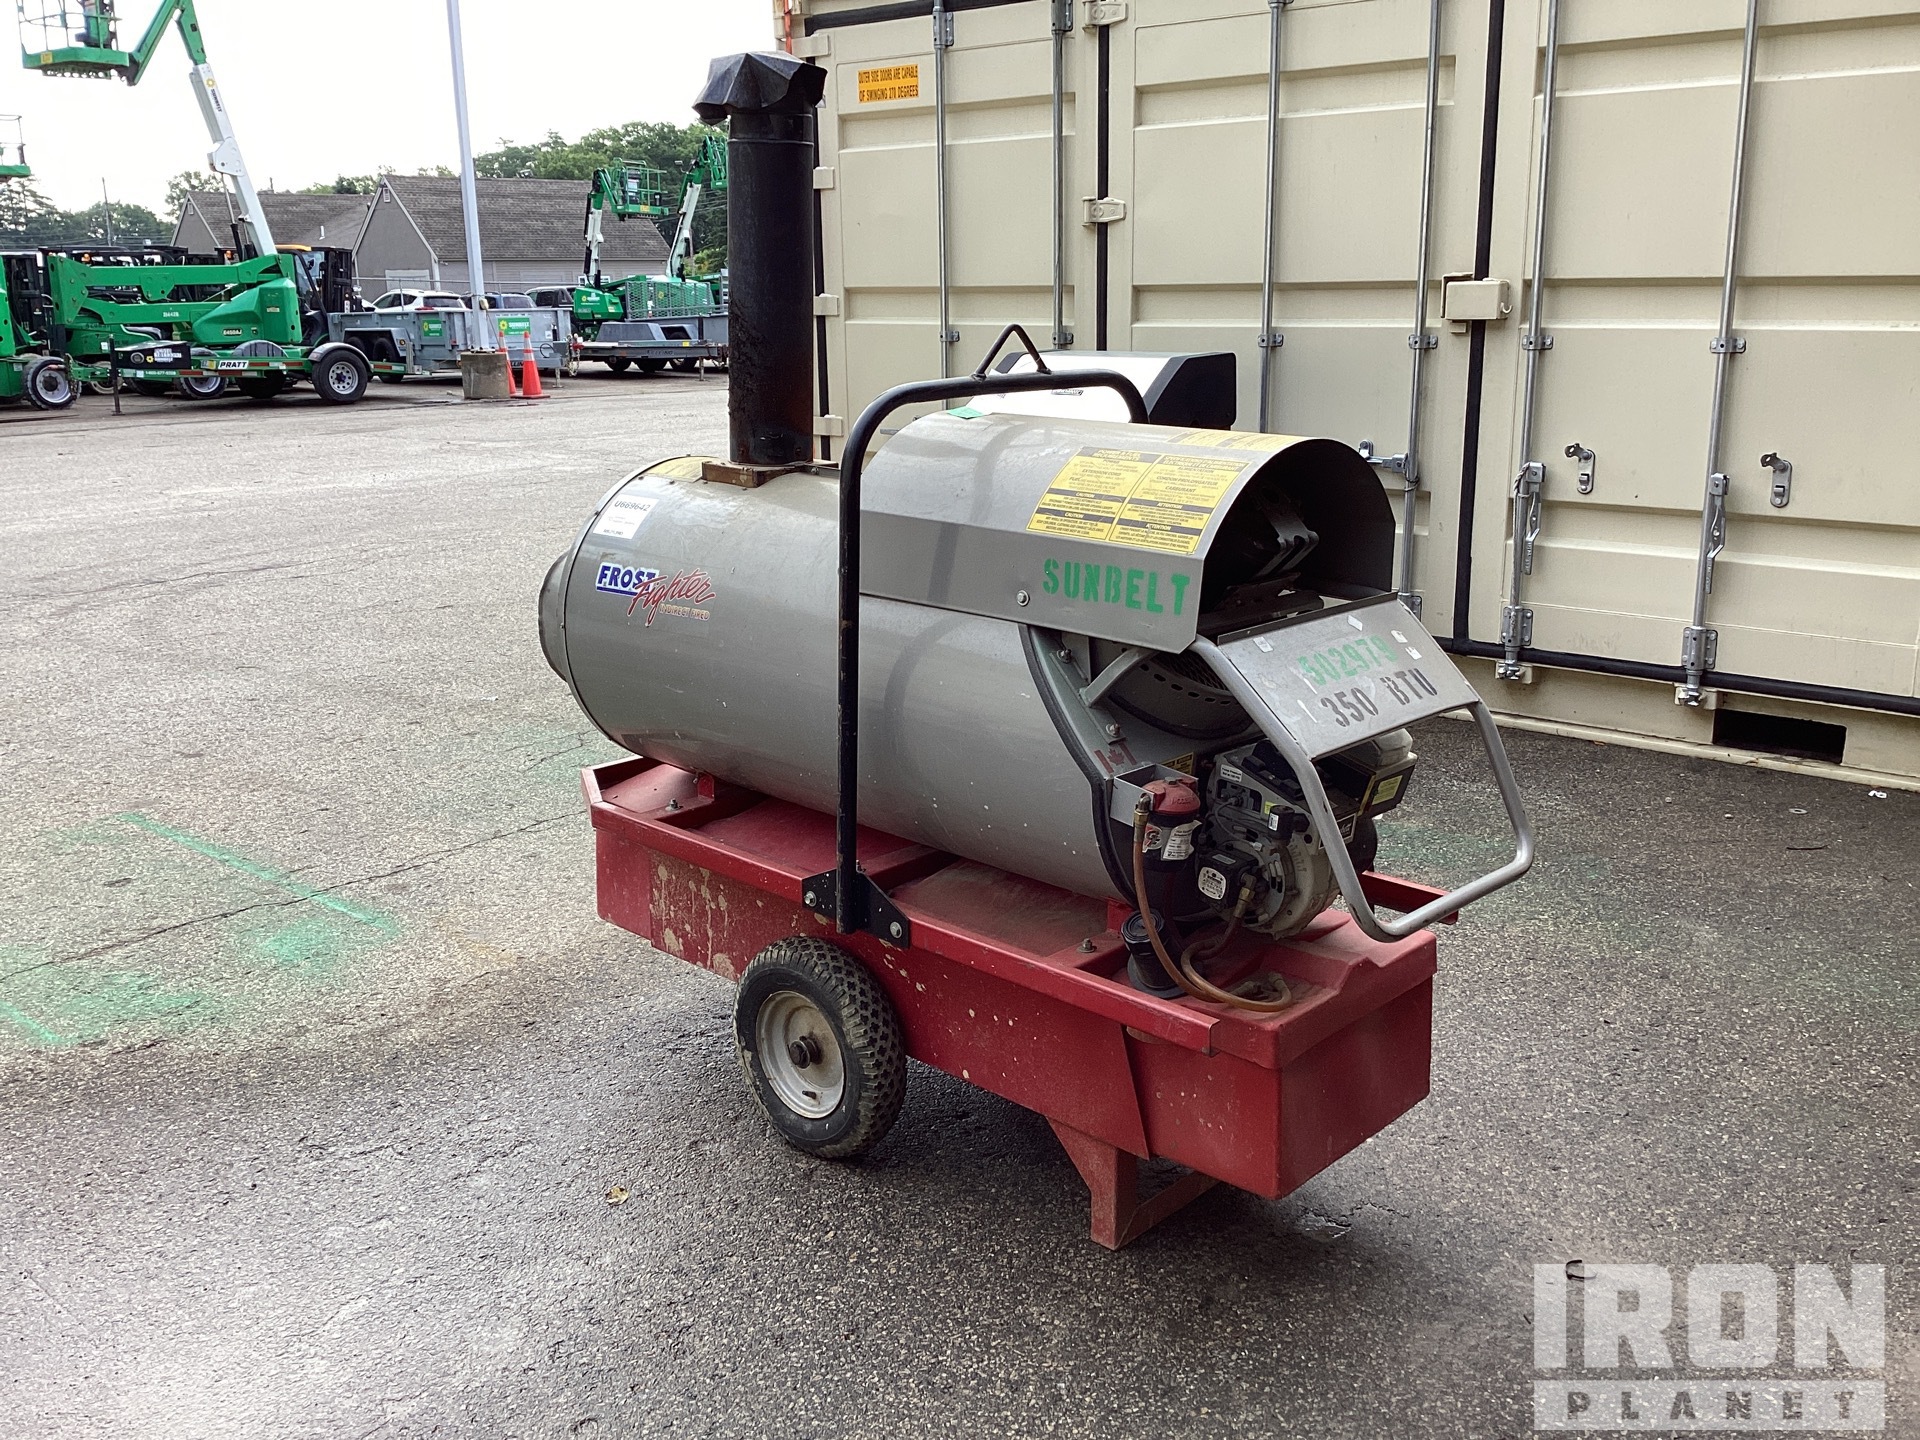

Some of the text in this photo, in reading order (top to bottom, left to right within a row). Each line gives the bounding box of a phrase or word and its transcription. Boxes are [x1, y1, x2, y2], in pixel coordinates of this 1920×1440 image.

[870, 70, 880, 82] SIDE
[893, 67, 901, 80] ARE
[901, 65, 918, 79] CAPABLE
[859, 90, 866, 102] OF
[897, 85, 919, 98] DEGREES
[1156, 502, 1183, 510] ATTENTION
[597, 564, 656, 591] FROST
[1043, 558, 1191, 616] SUNBELT
[626, 567, 717, 626] Fighter
[1320, 667, 1438, 728] 350 BTU
